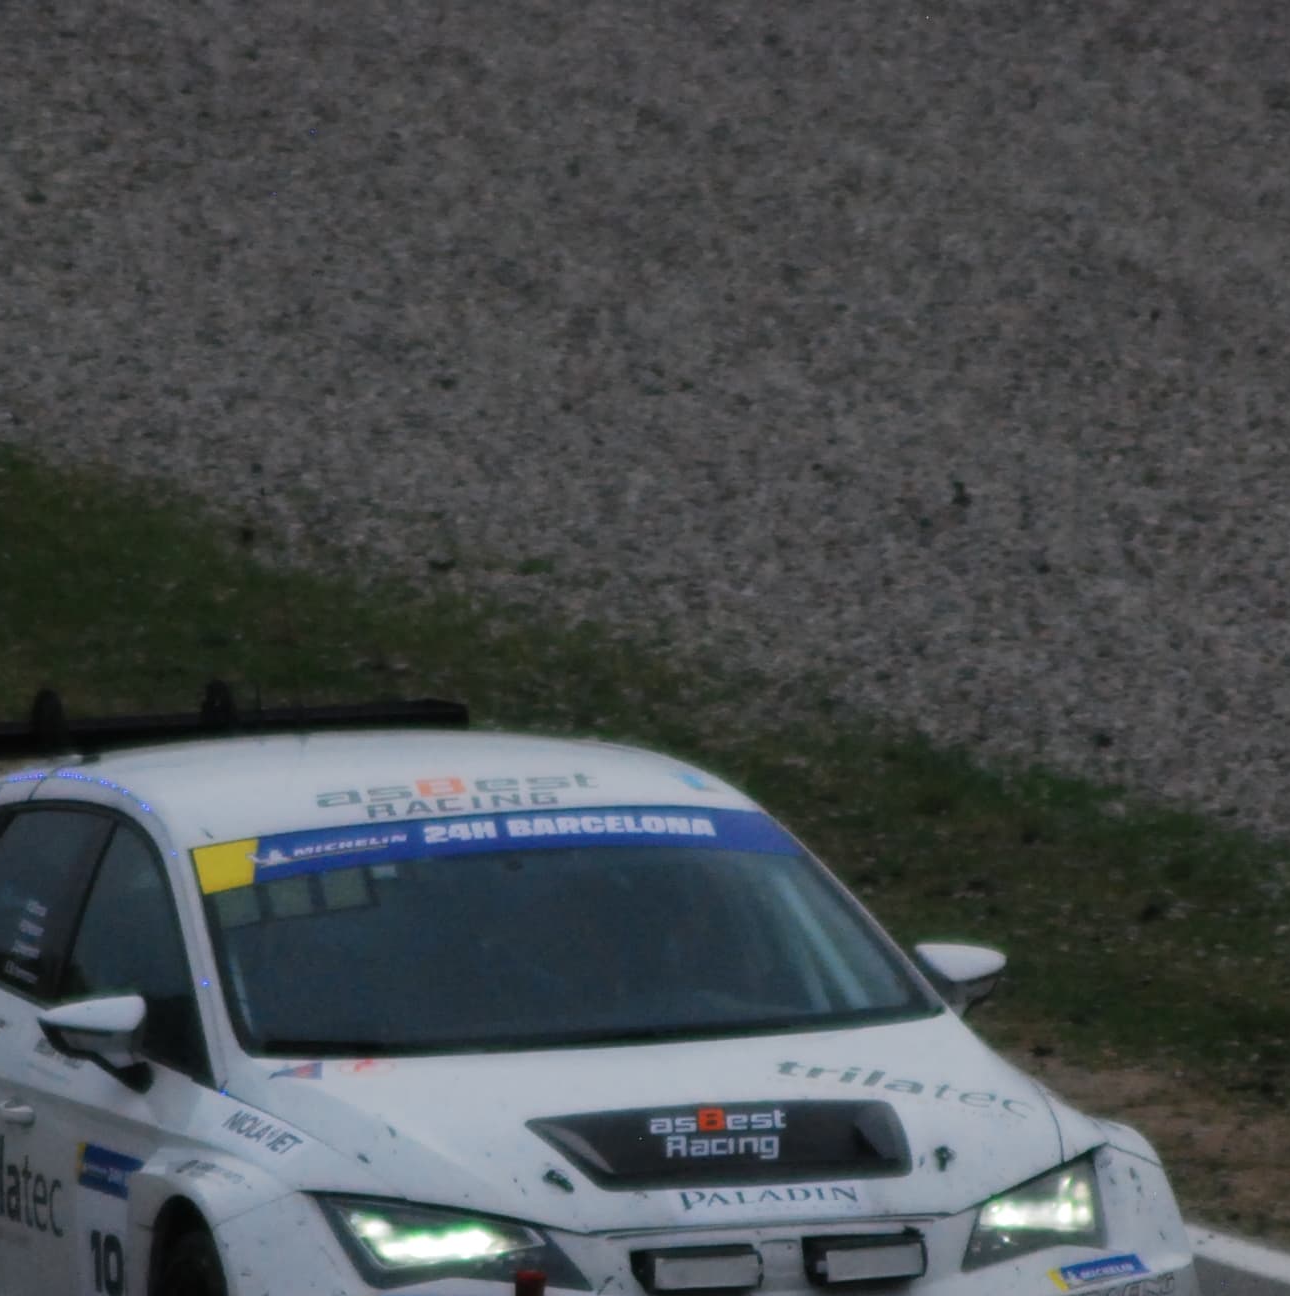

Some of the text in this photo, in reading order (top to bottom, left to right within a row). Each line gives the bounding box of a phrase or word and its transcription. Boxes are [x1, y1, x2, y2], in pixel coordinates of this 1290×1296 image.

[366, 793, 559, 819] RACING
[423, 815, 718, 844] 24H BARCELONA
[293, 831, 408, 857] MICHELIN
[776, 1060, 1038, 1119] trilatec
[666, 1135, 780, 1160] Racing
[679, 1186, 859, 1212] PALADIN
